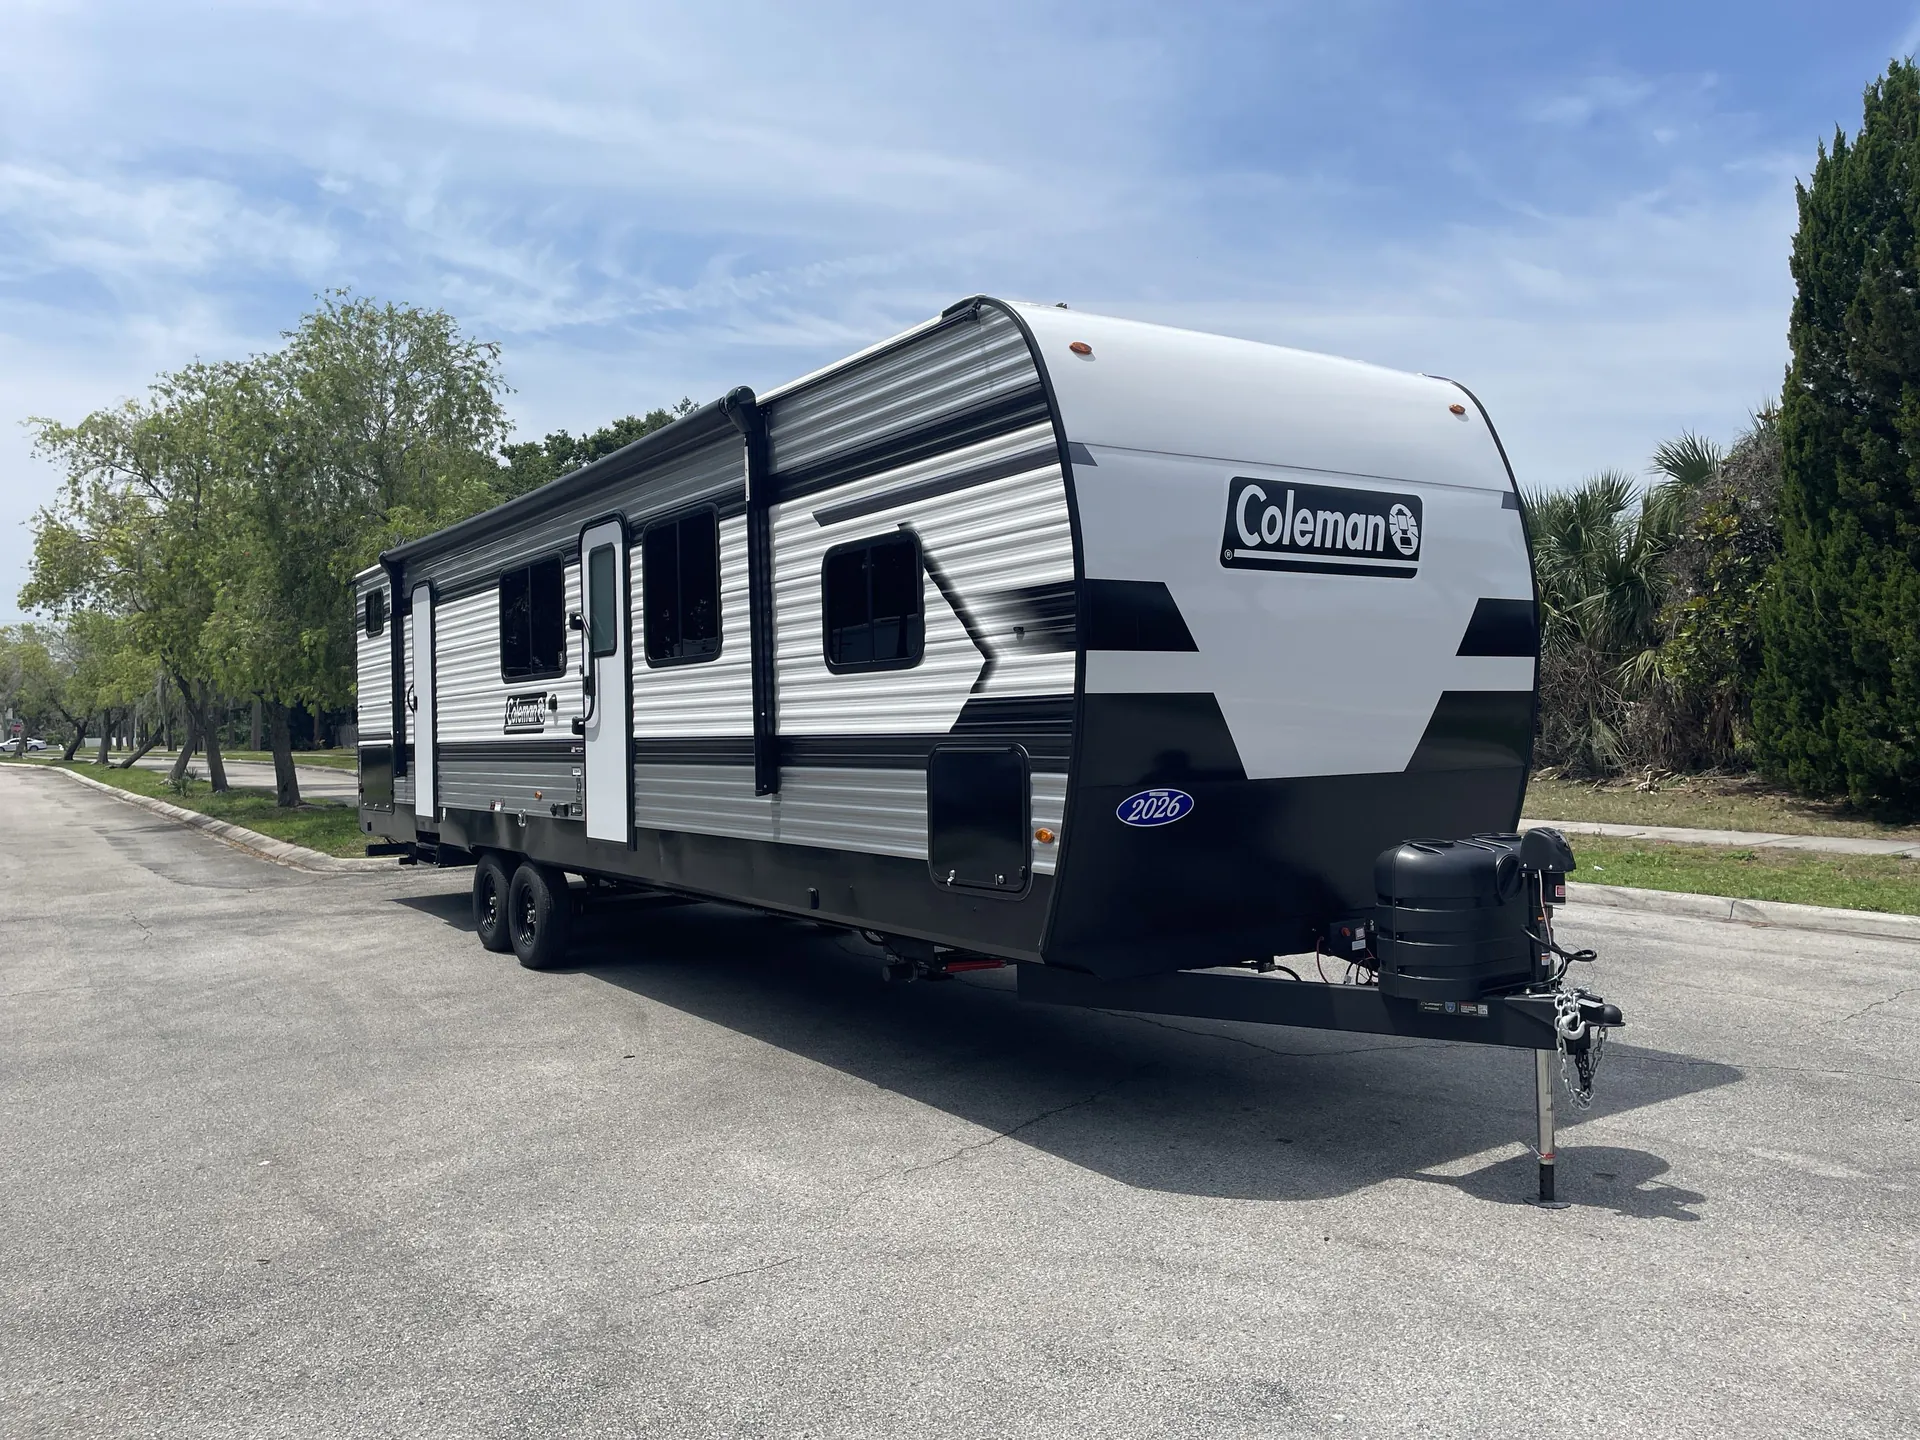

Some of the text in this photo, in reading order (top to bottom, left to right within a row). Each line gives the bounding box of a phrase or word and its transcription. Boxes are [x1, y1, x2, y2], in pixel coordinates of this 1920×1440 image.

[1236, 484, 1386, 552] Coleman
[507, 697, 538, 725] Coleman
[1127, 795, 1184, 821] 2026
